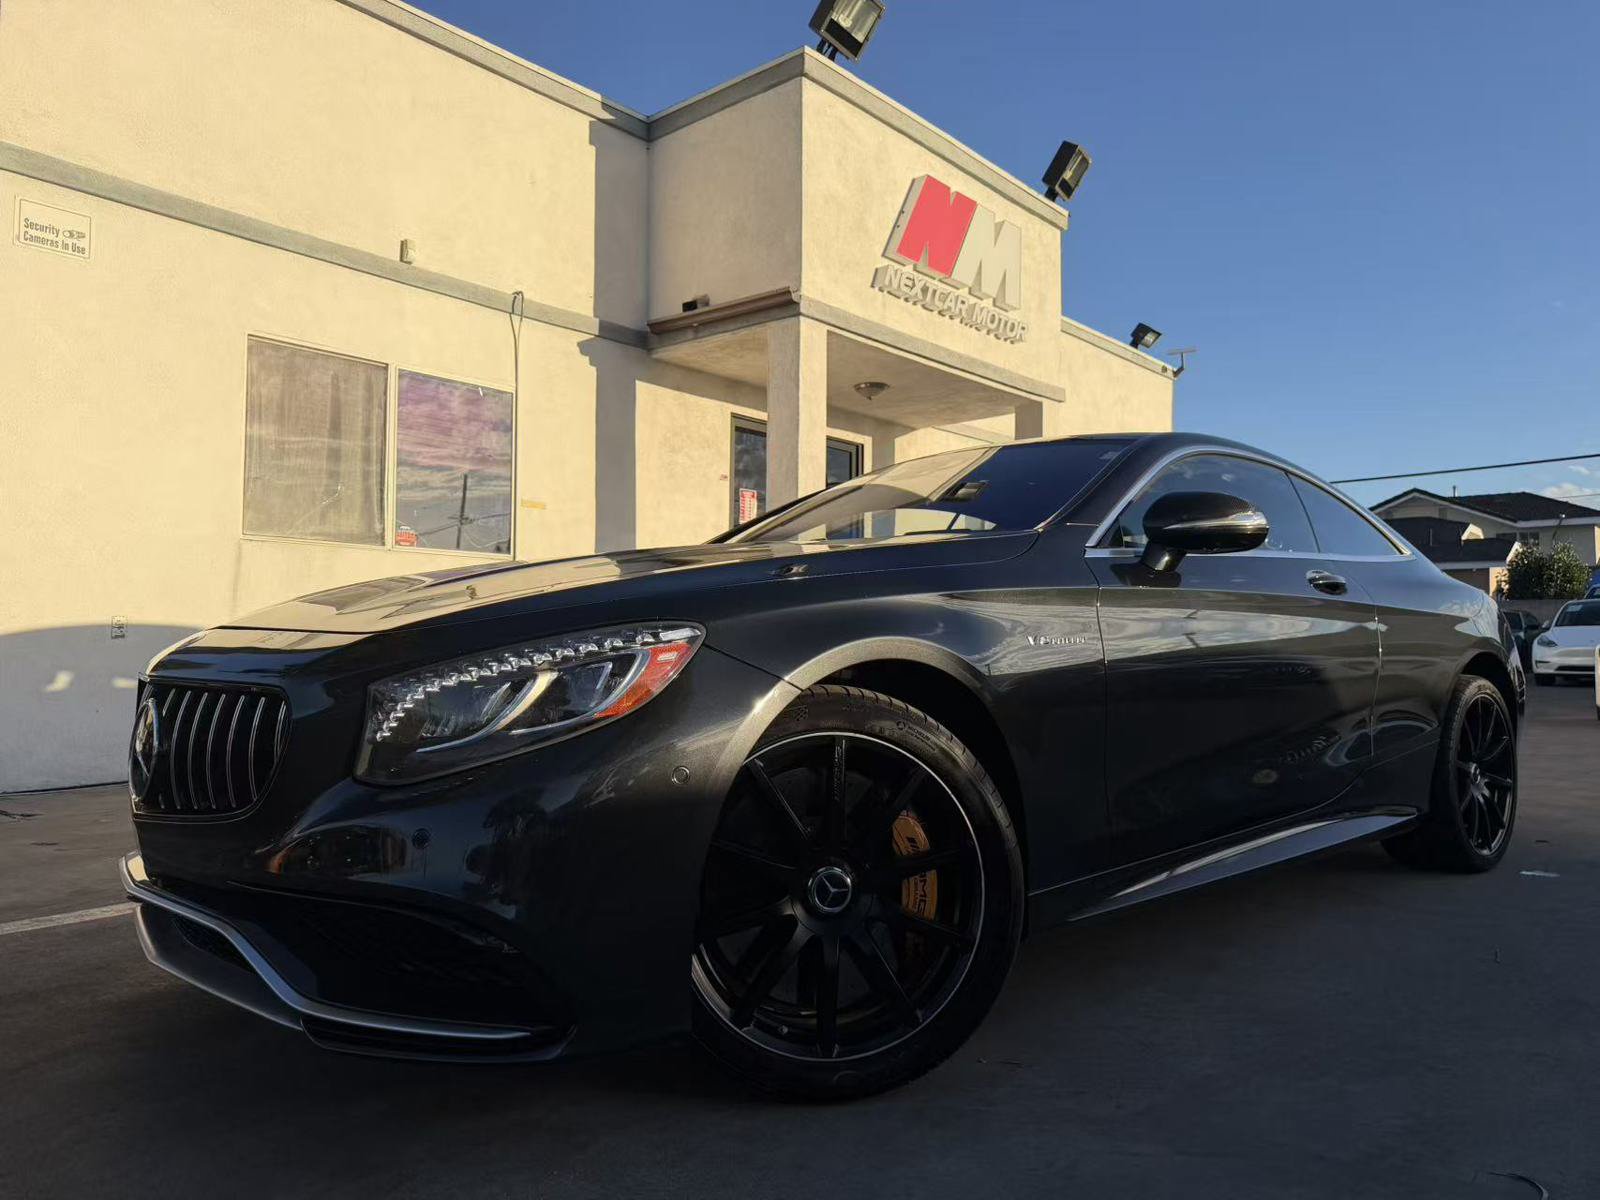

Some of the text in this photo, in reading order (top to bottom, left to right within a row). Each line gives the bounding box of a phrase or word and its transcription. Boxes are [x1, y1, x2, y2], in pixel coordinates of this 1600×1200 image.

[23, 230, 60, 249] Cameras
[71, 242, 86, 255] Use
[24, 217, 60, 238] Security
[884, 174, 1022, 311] NM
[882, 264, 1028, 343] NEXTCAR MOTOR
